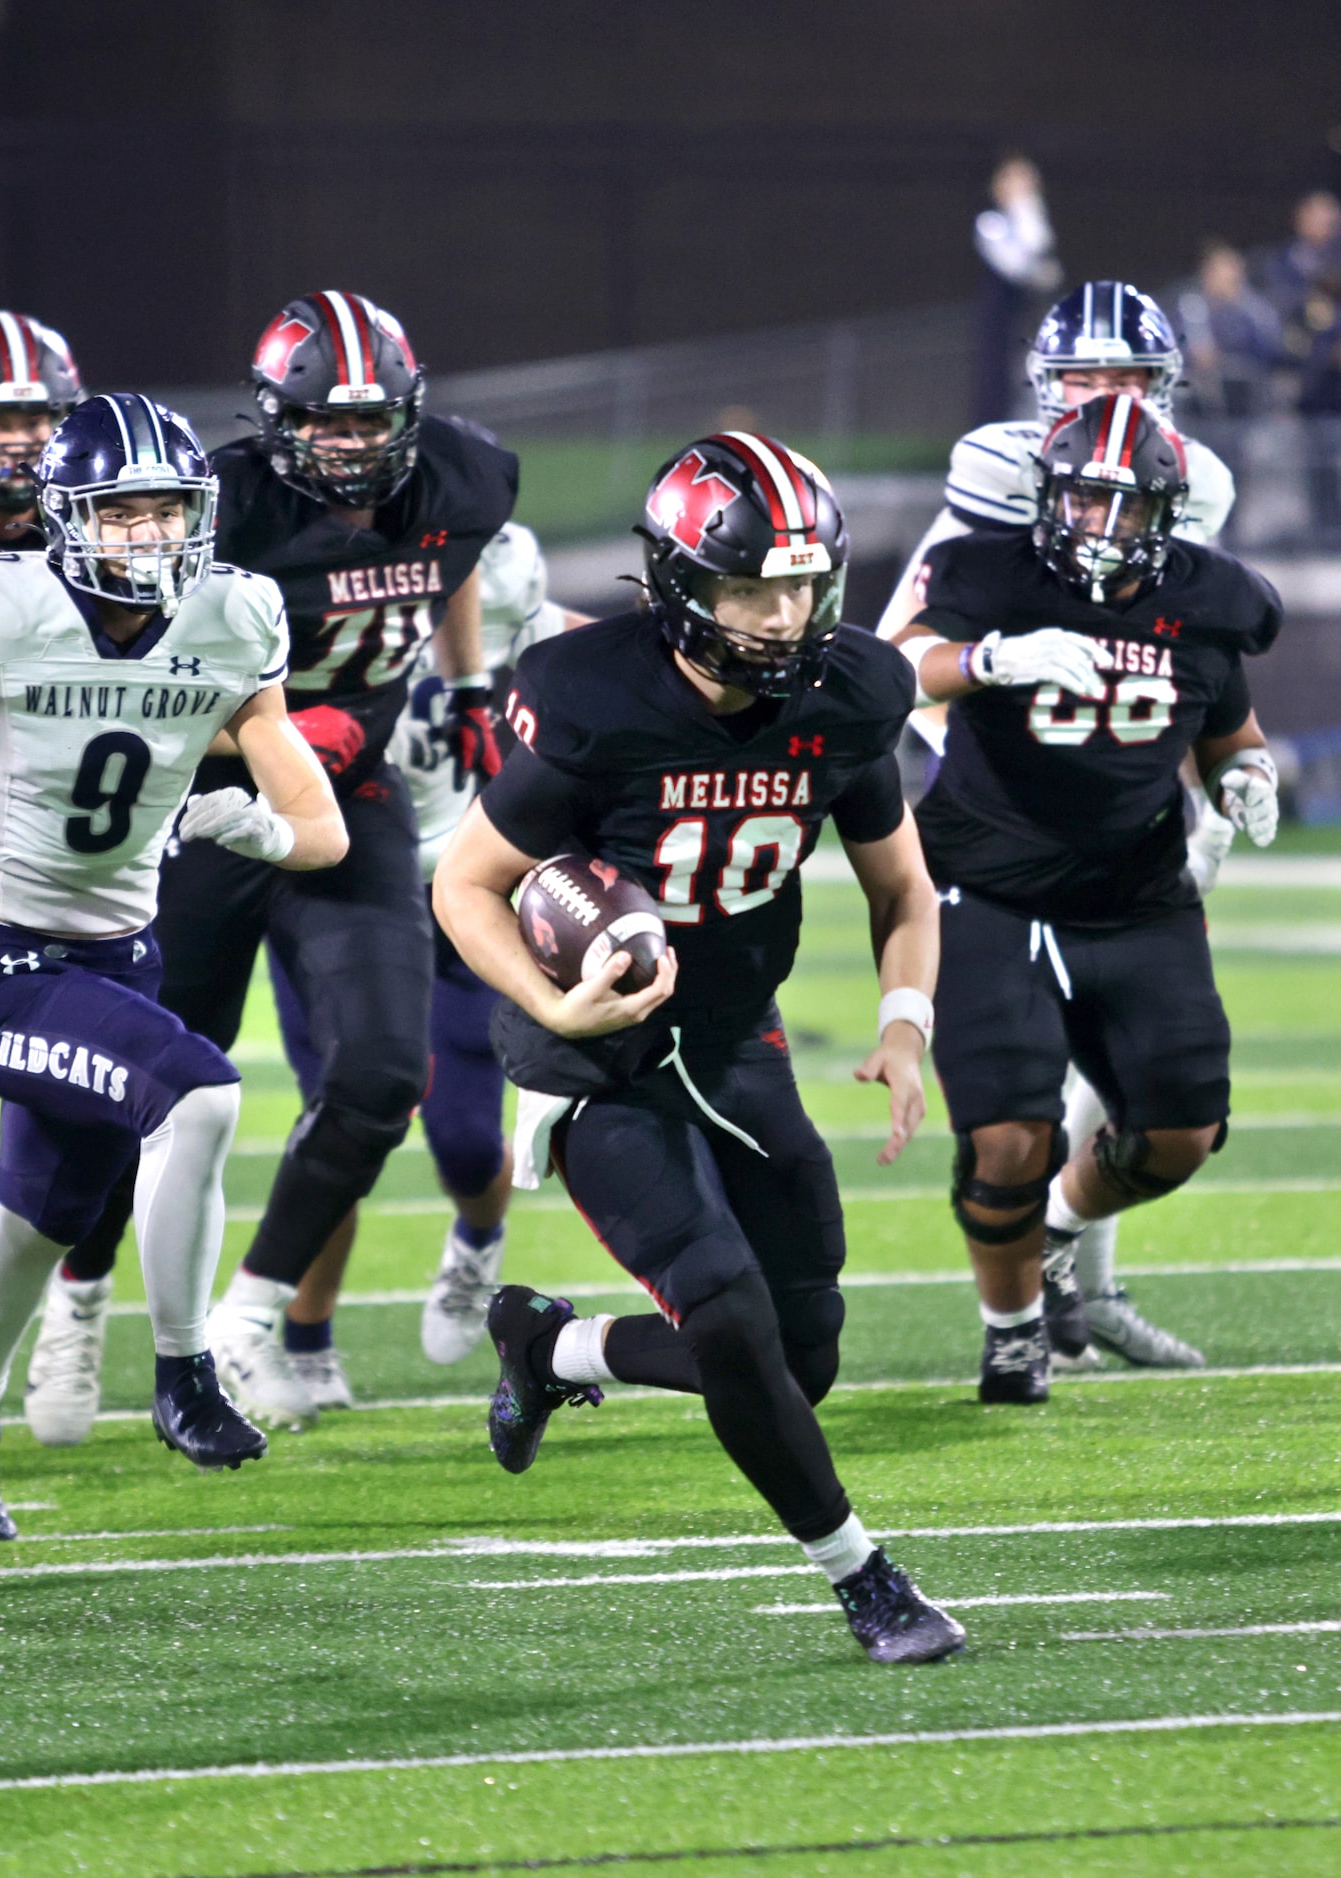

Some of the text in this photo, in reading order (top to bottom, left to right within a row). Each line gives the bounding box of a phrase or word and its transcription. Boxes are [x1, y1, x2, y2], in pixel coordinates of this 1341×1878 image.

[646, 449, 741, 555] M
[327, 560, 442, 604] MELISSA
[284, 600, 435, 690] 70
[25, 685, 221, 719] WALNUT GROVE
[65, 730, 152, 854] 9
[660, 770, 811, 810] MELISSA
[654, 811, 805, 926] 10
